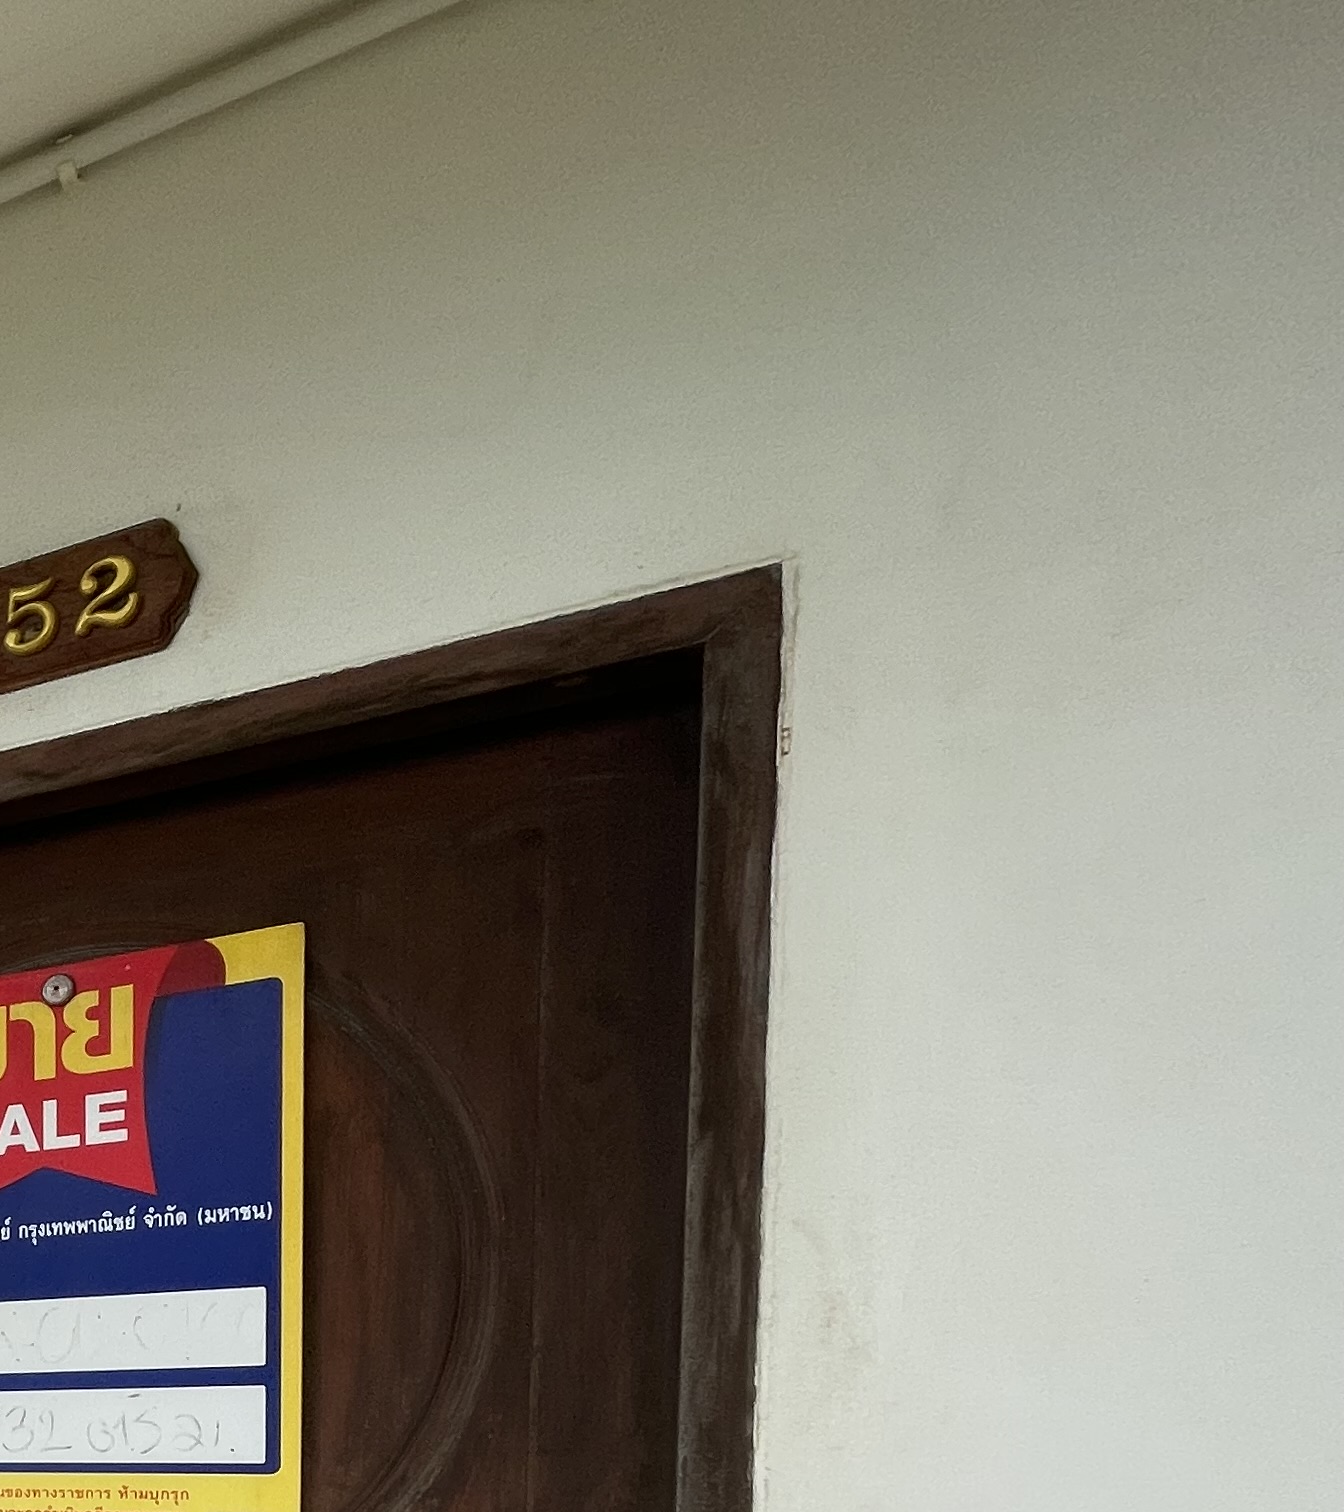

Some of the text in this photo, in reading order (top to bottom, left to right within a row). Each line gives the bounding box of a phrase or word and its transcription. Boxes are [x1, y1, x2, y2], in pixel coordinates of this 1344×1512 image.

[4, 554, 139, 656] 52
[18, 1206, 136, 1246] กรุงเทพพาณิชย์
[143, 1204, 188, 1229] จำกัด
[197, 1201, 274, 1226] (มหาชน)
[118, 1484, 190, 1506] ห้ามบุกรุก
